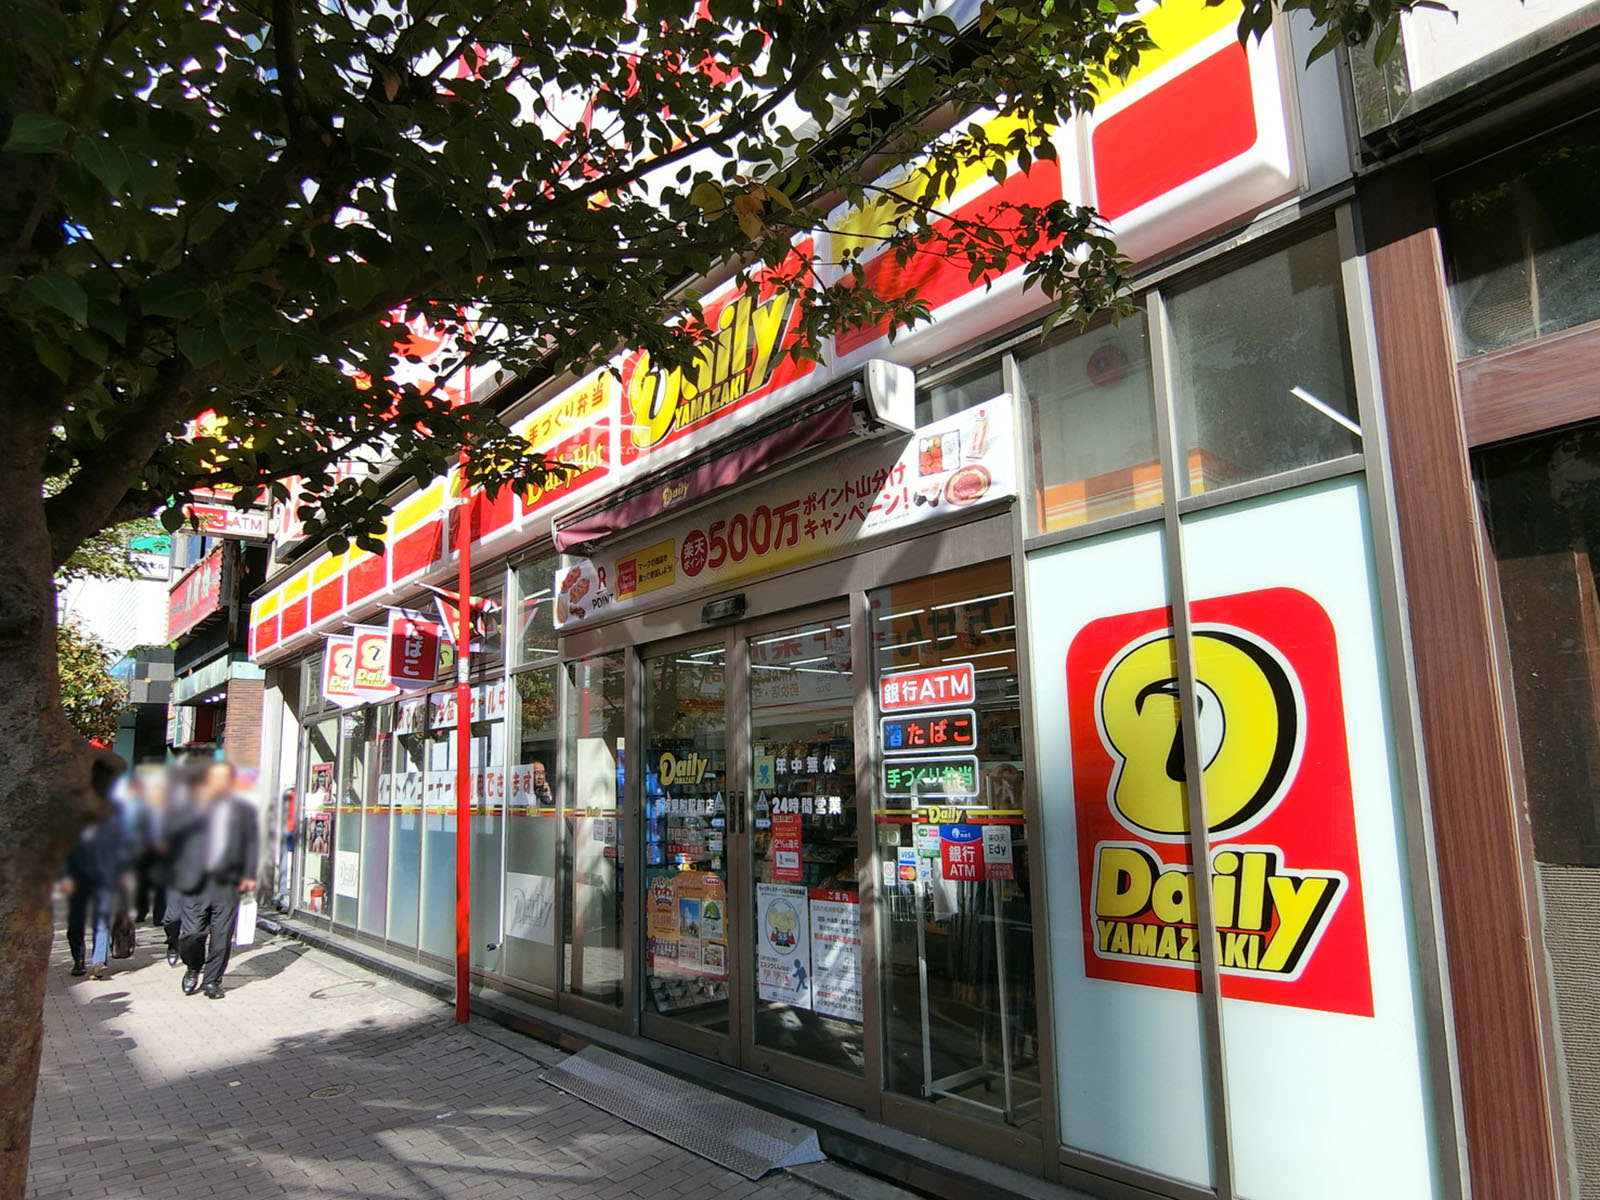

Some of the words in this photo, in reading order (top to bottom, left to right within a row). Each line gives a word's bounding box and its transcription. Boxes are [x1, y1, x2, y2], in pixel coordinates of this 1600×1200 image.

[528, 381, 604, 444] 手づくり弁当
[675, 373, 747, 430] YAMAZAKI
[803, 461, 907, 517] ポイント山分け
[231, 517, 263, 531] ATM
[708, 499, 800, 569] 500万
[684, 536, 705, 560] 楽天
[592, 593, 614, 610] POINT
[403, 622, 424, 676] たばこ
[884, 673, 970, 704] 銀行ATM
[907, 719, 971, 745] たばこ
[659, 752, 708, 786] Daily
[776, 755, 836, 775] 年中無休
[887, 765, 973, 789] 手づくり弁当
[772, 796, 842, 815] 24時間営業
[928, 805, 963, 824] Daily
[901, 850, 916, 859] VISA
[949, 845, 976, 863] 銀行
[988, 844, 1007, 856] Edy
[950, 864, 976, 877] ATM
[1095, 847, 1338, 973] Daily
